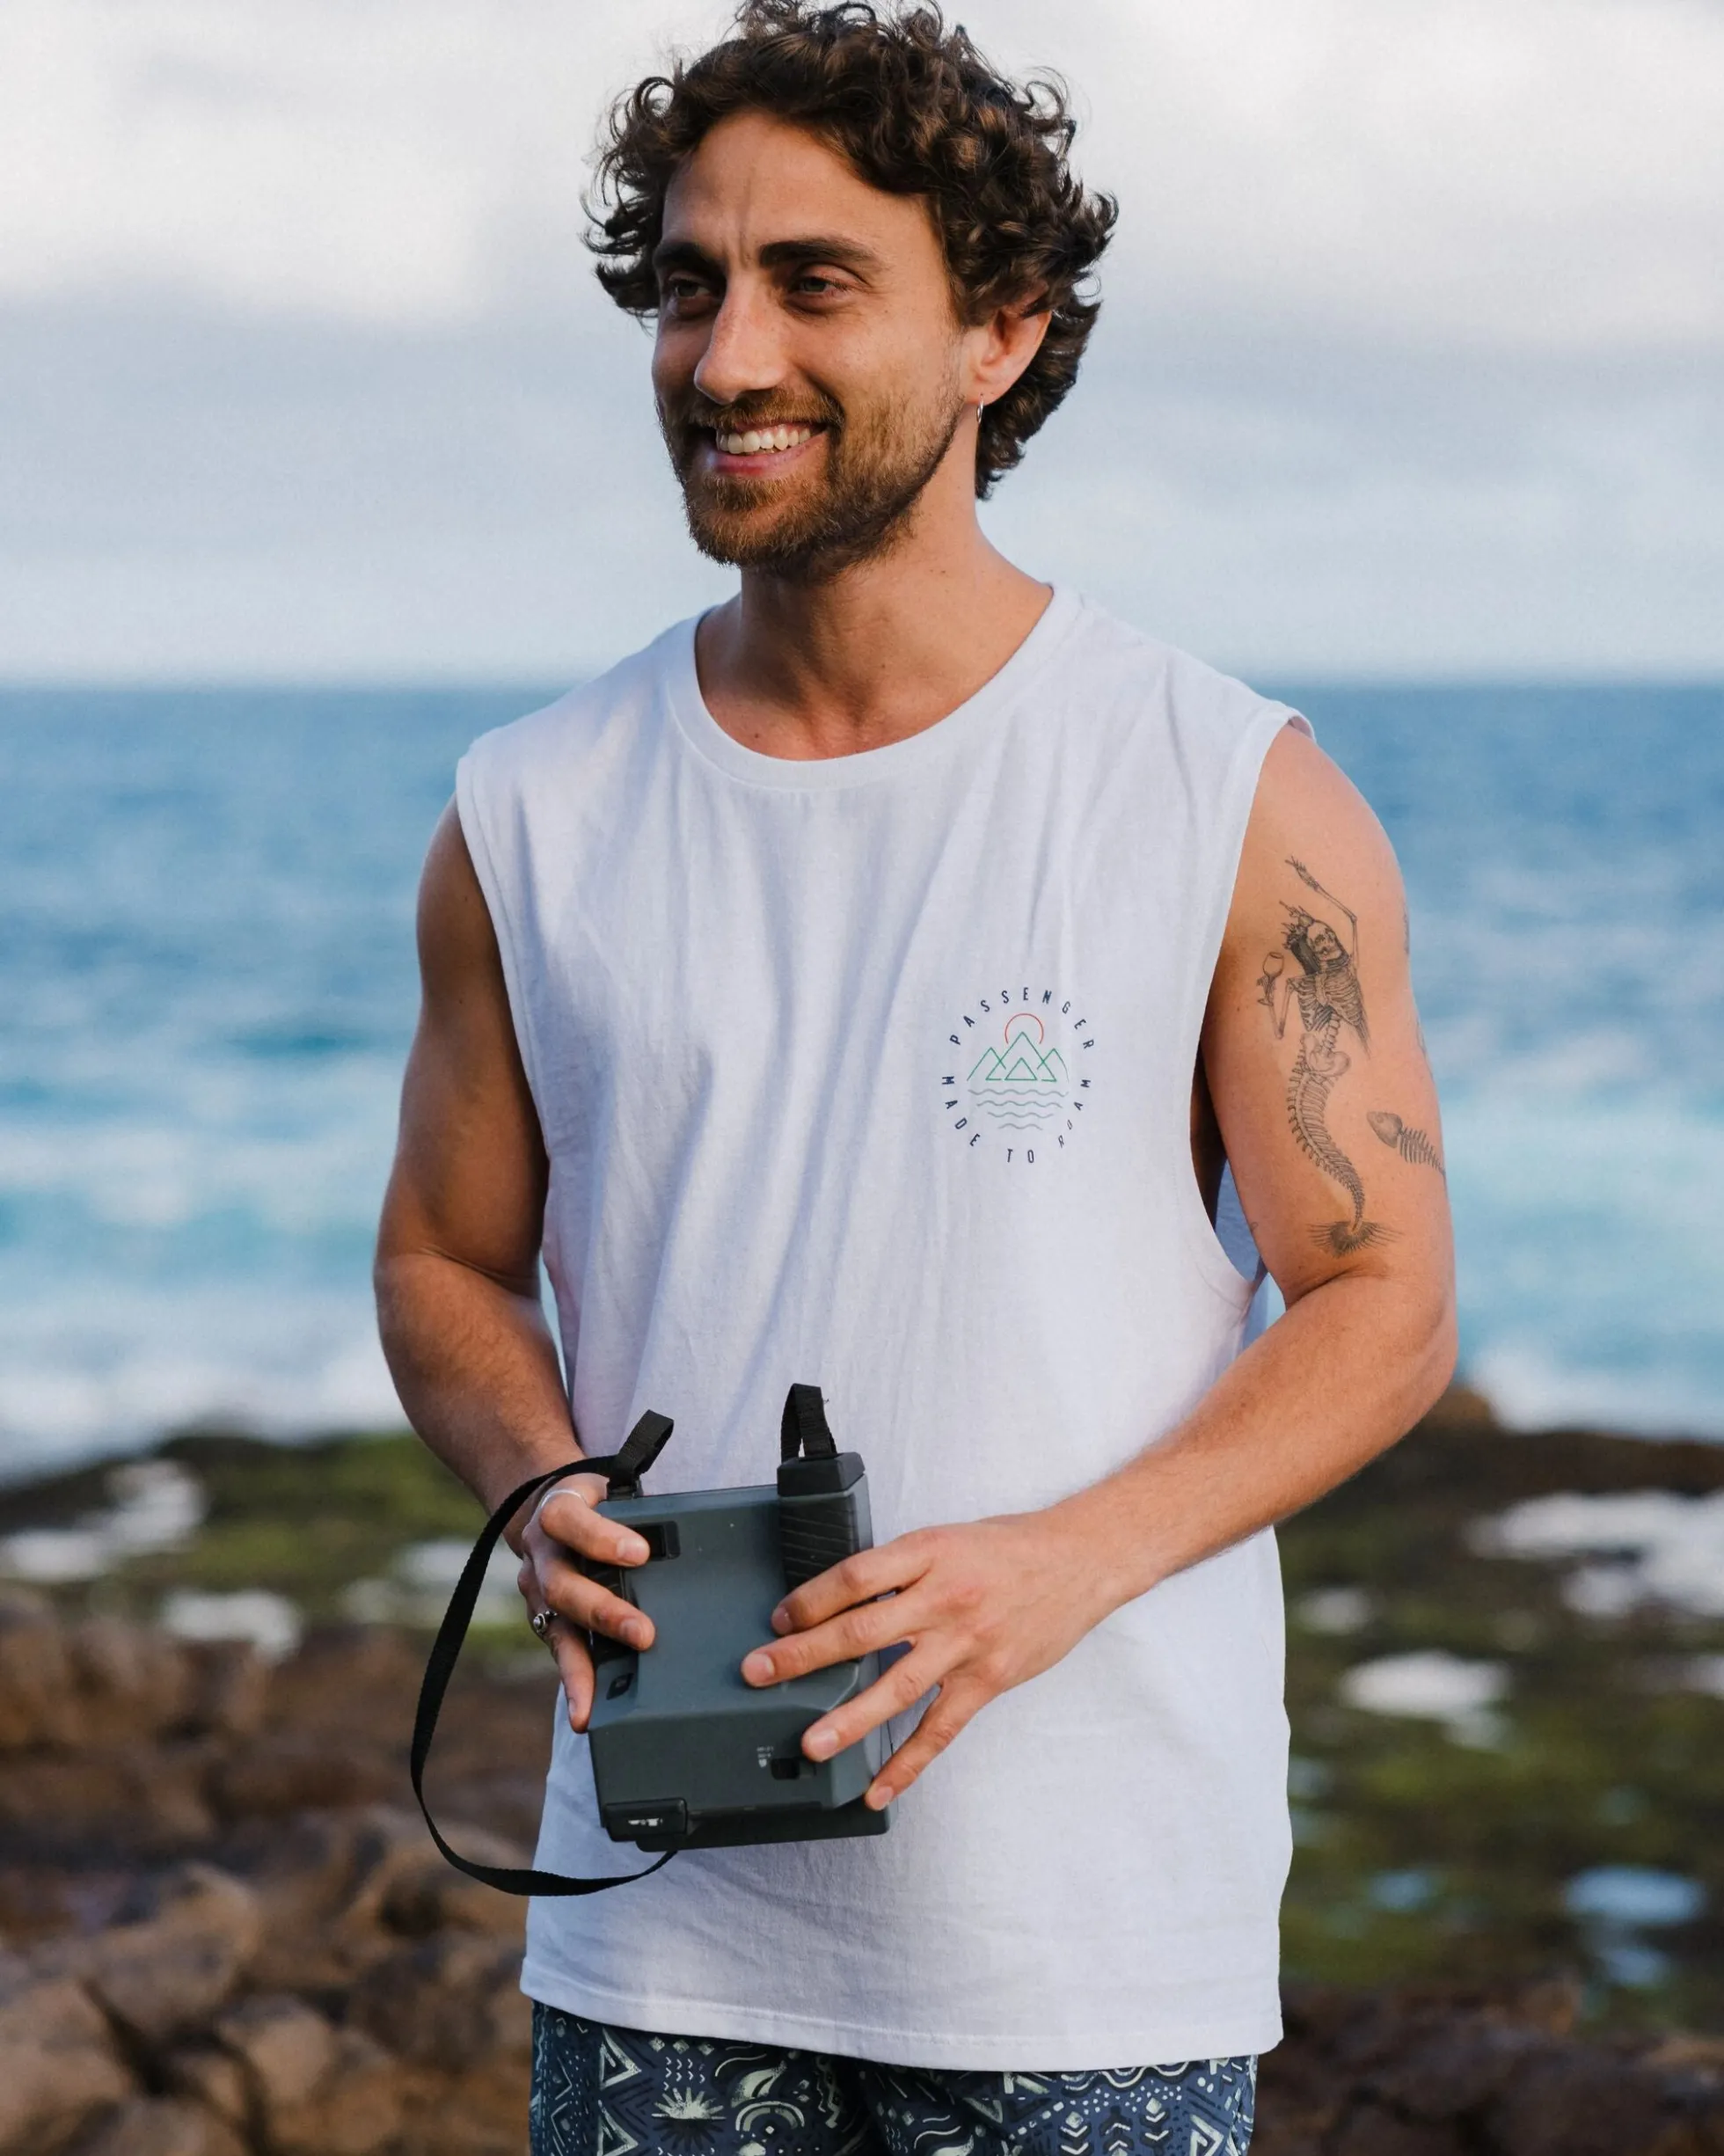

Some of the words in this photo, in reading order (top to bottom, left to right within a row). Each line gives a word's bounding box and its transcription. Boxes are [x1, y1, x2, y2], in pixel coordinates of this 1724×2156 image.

[948, 986, 1095, 1050] PASSENGER
[941, 1075, 981, 1147] MADE
[1006, 1148, 1035, 1164] TO
[1057, 1078, 1092, 1149] ROAM
